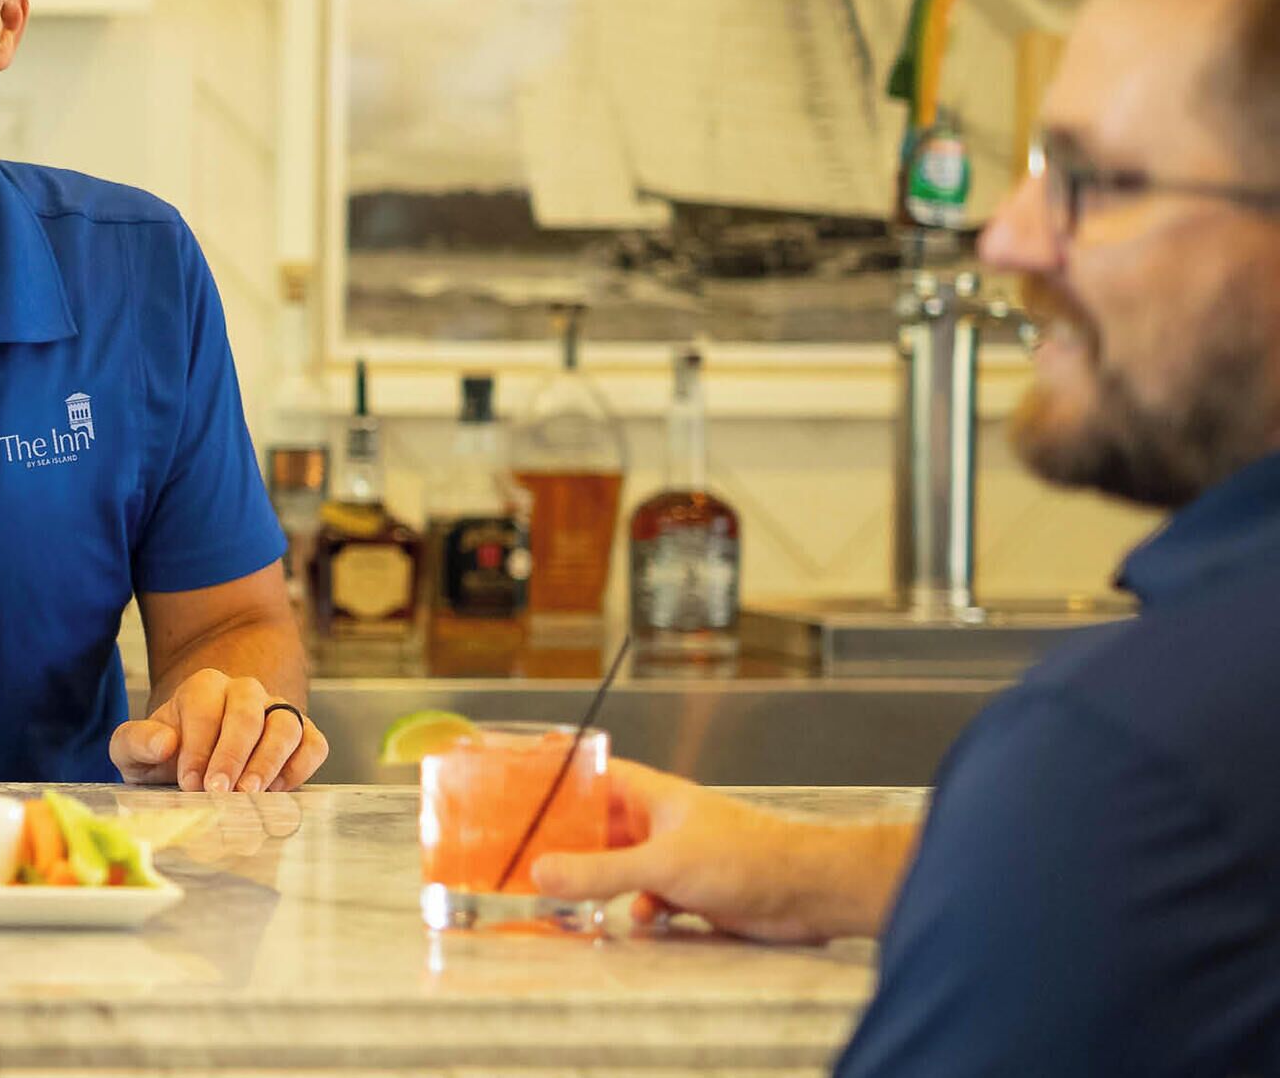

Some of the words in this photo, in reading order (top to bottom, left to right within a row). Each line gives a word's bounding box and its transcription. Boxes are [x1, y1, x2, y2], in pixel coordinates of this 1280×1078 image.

[51, 428, 90, 454] Inn
[26, 460, 37, 469] BY
[37, 458, 51, 467] SEA
[51, 454, 78, 464] ISLAND
